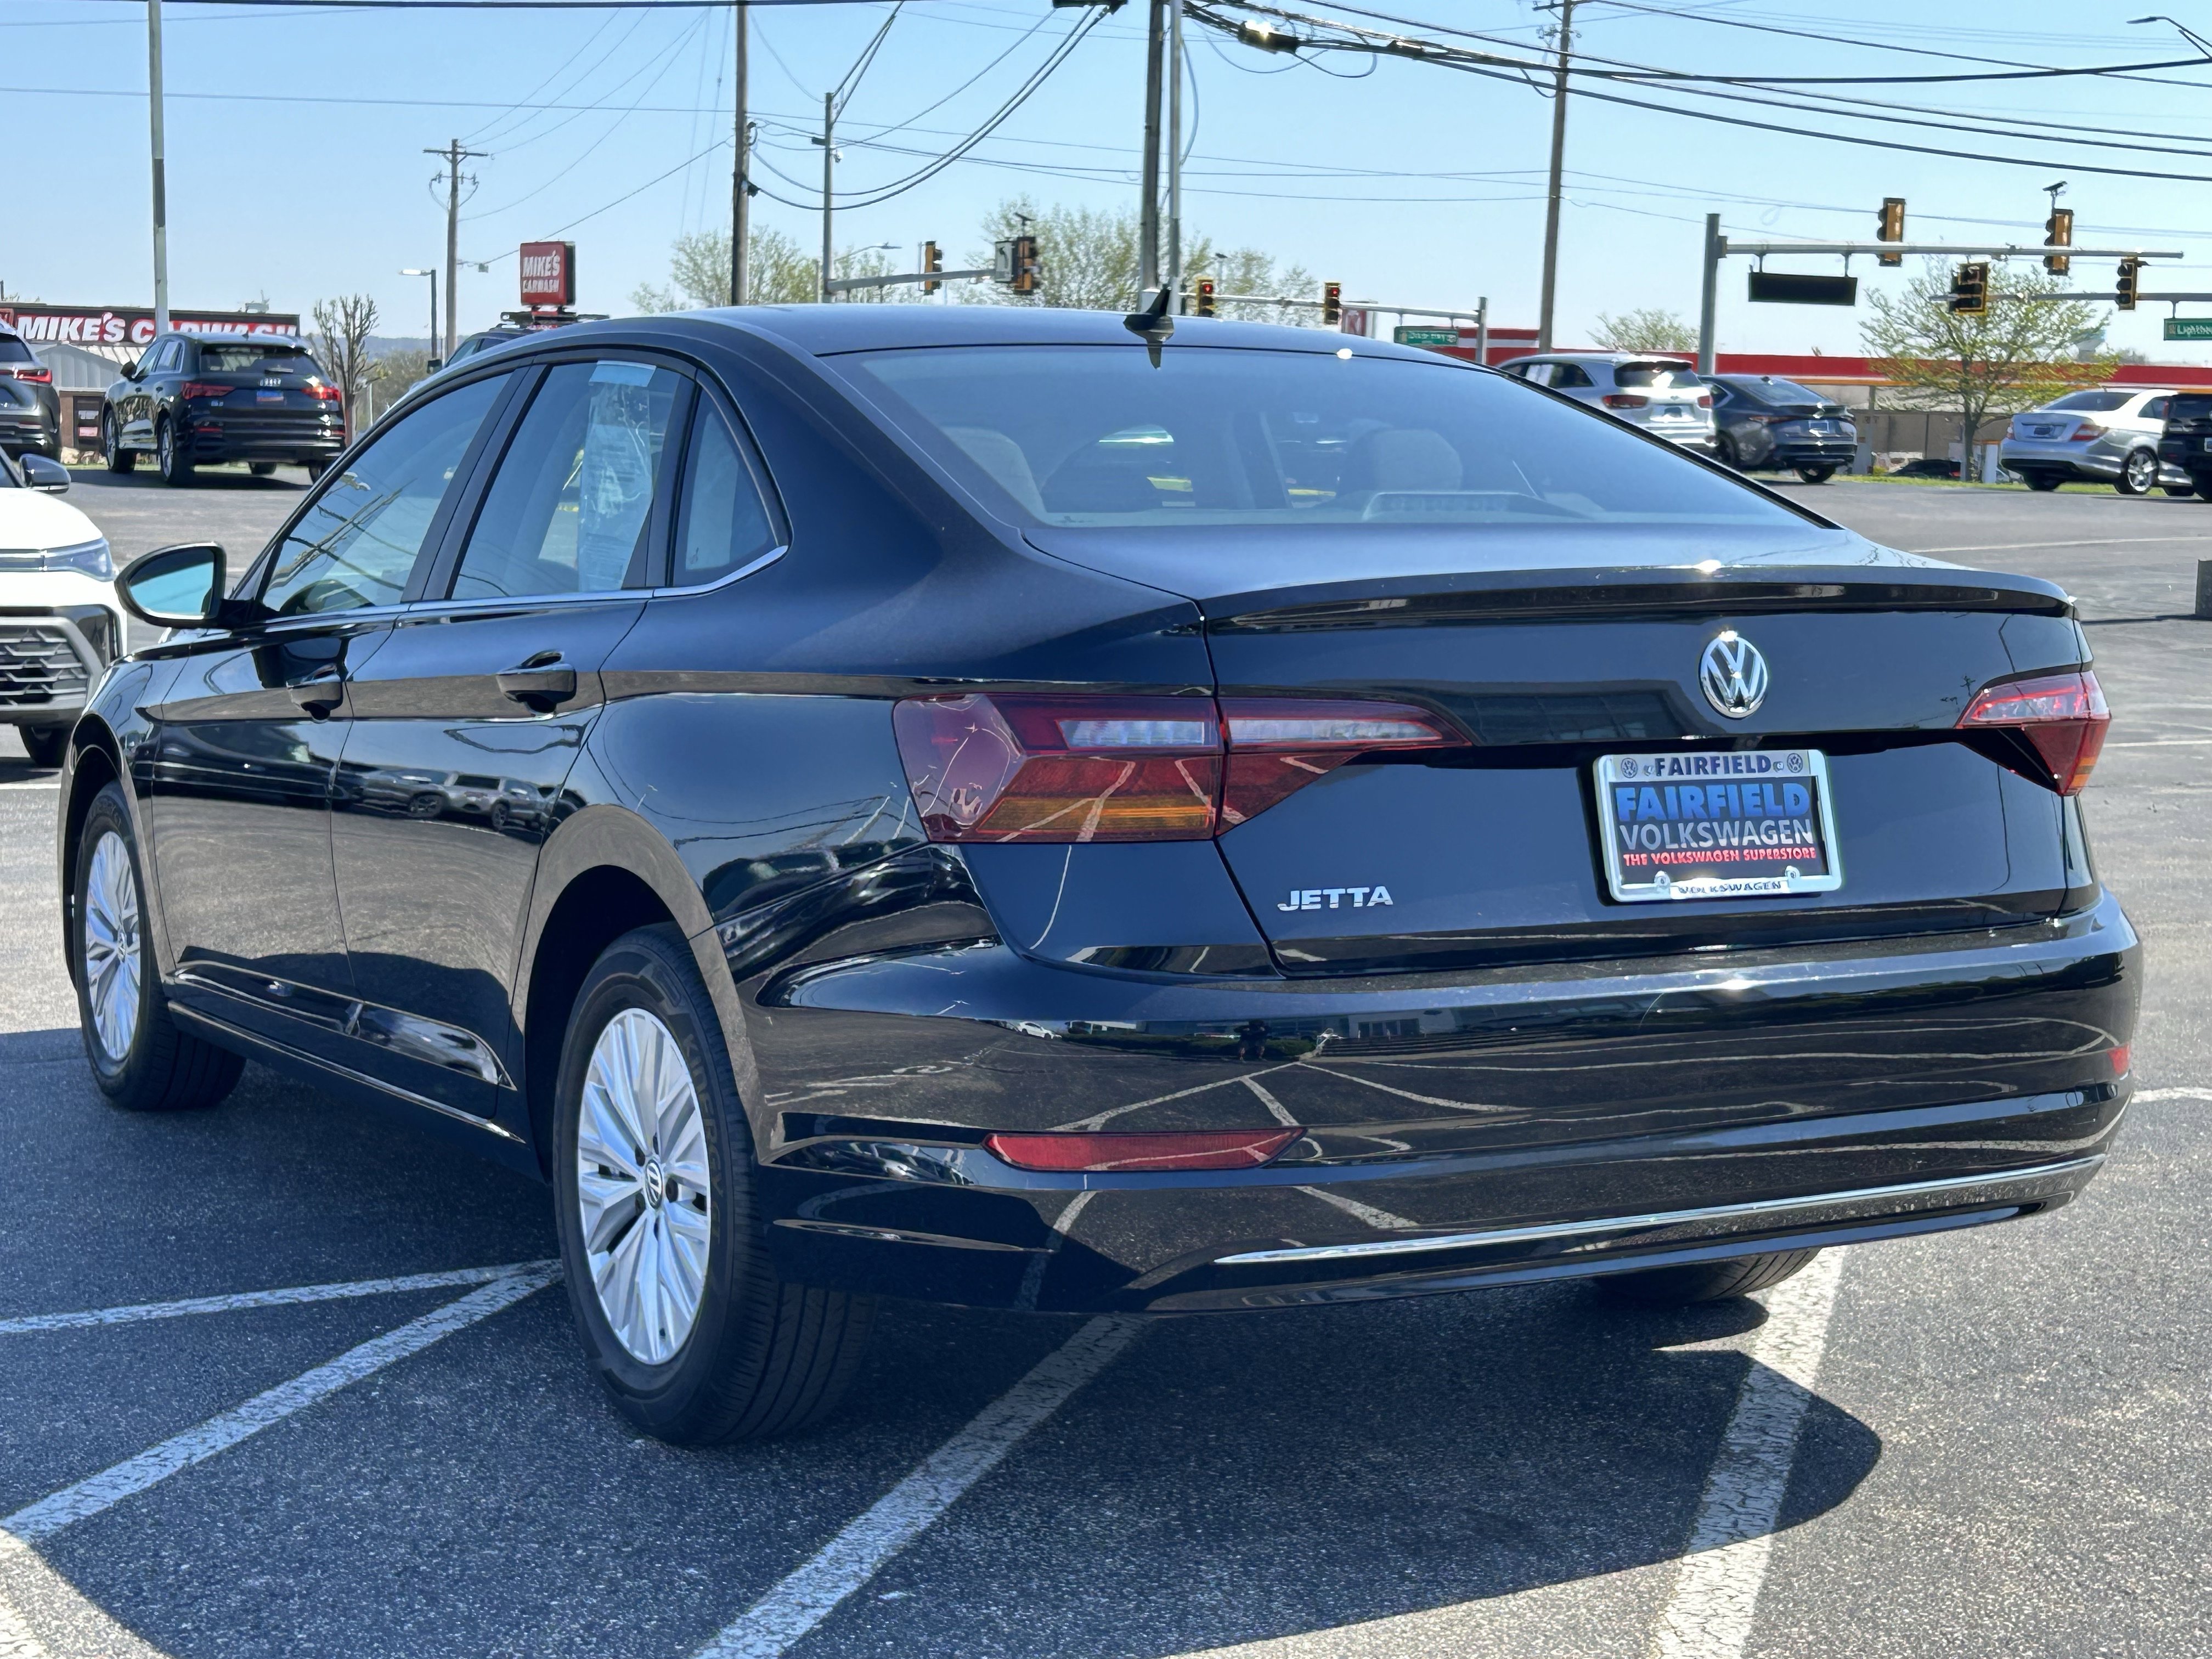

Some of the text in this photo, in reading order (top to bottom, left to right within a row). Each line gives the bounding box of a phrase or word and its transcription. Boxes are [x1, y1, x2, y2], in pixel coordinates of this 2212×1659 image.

[522, 250, 560, 277] MIKE'S
[17, 312, 126, 343] MIKE'S
[1654, 755, 1771, 777] FAIRFIELD
[1615, 783, 1810, 822] FAIRFIELD
[1619, 819, 1814, 850] VOLKSWAGEN
[1623, 847, 1816, 867] THE VOLKSWAGEN SUPERSTORE
[1277, 885, 1394, 912] JETTA
[1678, 881, 1782, 895] VOLKSWAGEN
